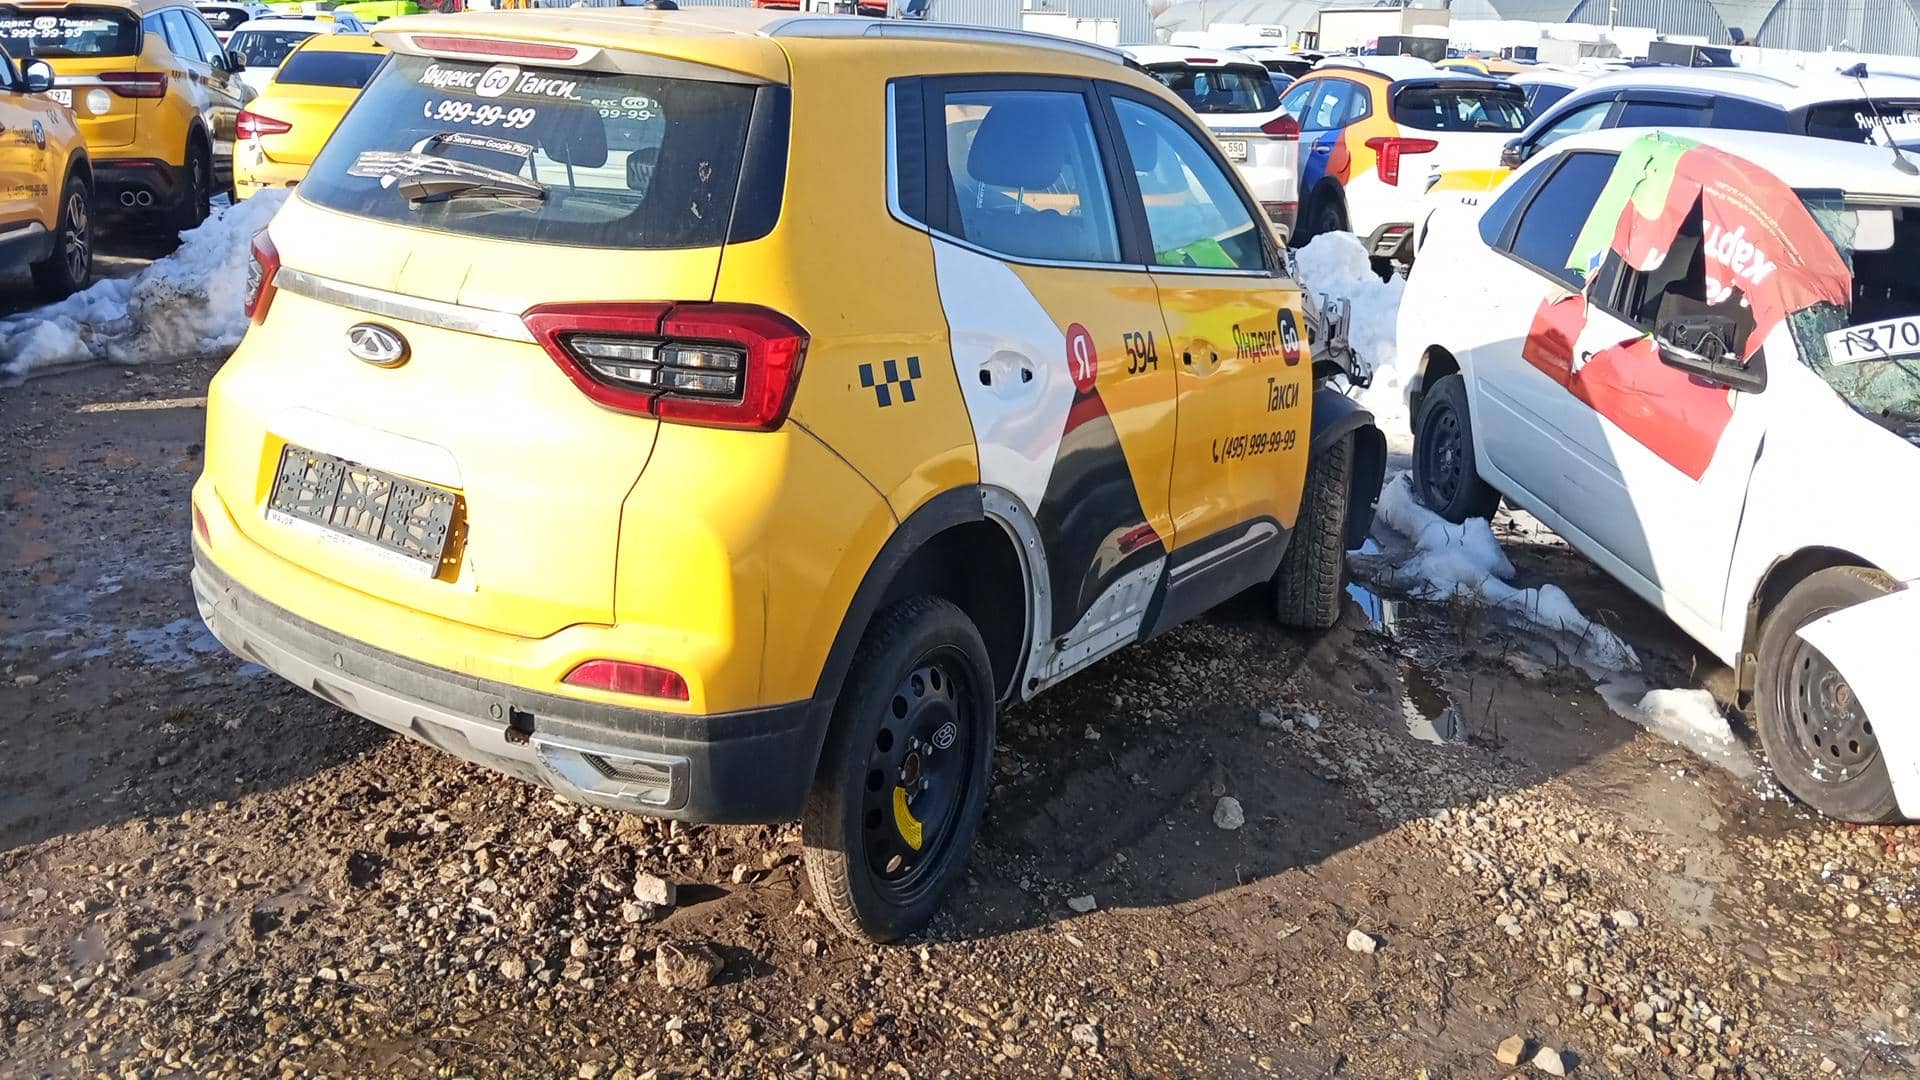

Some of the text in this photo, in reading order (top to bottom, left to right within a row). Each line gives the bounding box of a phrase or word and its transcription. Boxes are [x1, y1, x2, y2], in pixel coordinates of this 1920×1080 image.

[11, 27, 83, 38] 999-99-99
[418, 64, 481, 88] Яндекс
[515, 72, 581, 100] Такси
[433, 101, 536, 128] 999-99-99
[486, 139, 512, 151] Google
[1074, 334, 1089, 381] Я
[1123, 330, 1158, 375] 594
[1232, 319, 1299, 363] Яндекс Go
[1267, 377, 1298, 412] Такси
[1222, 429, 1296, 462] (495) 999-99-99
